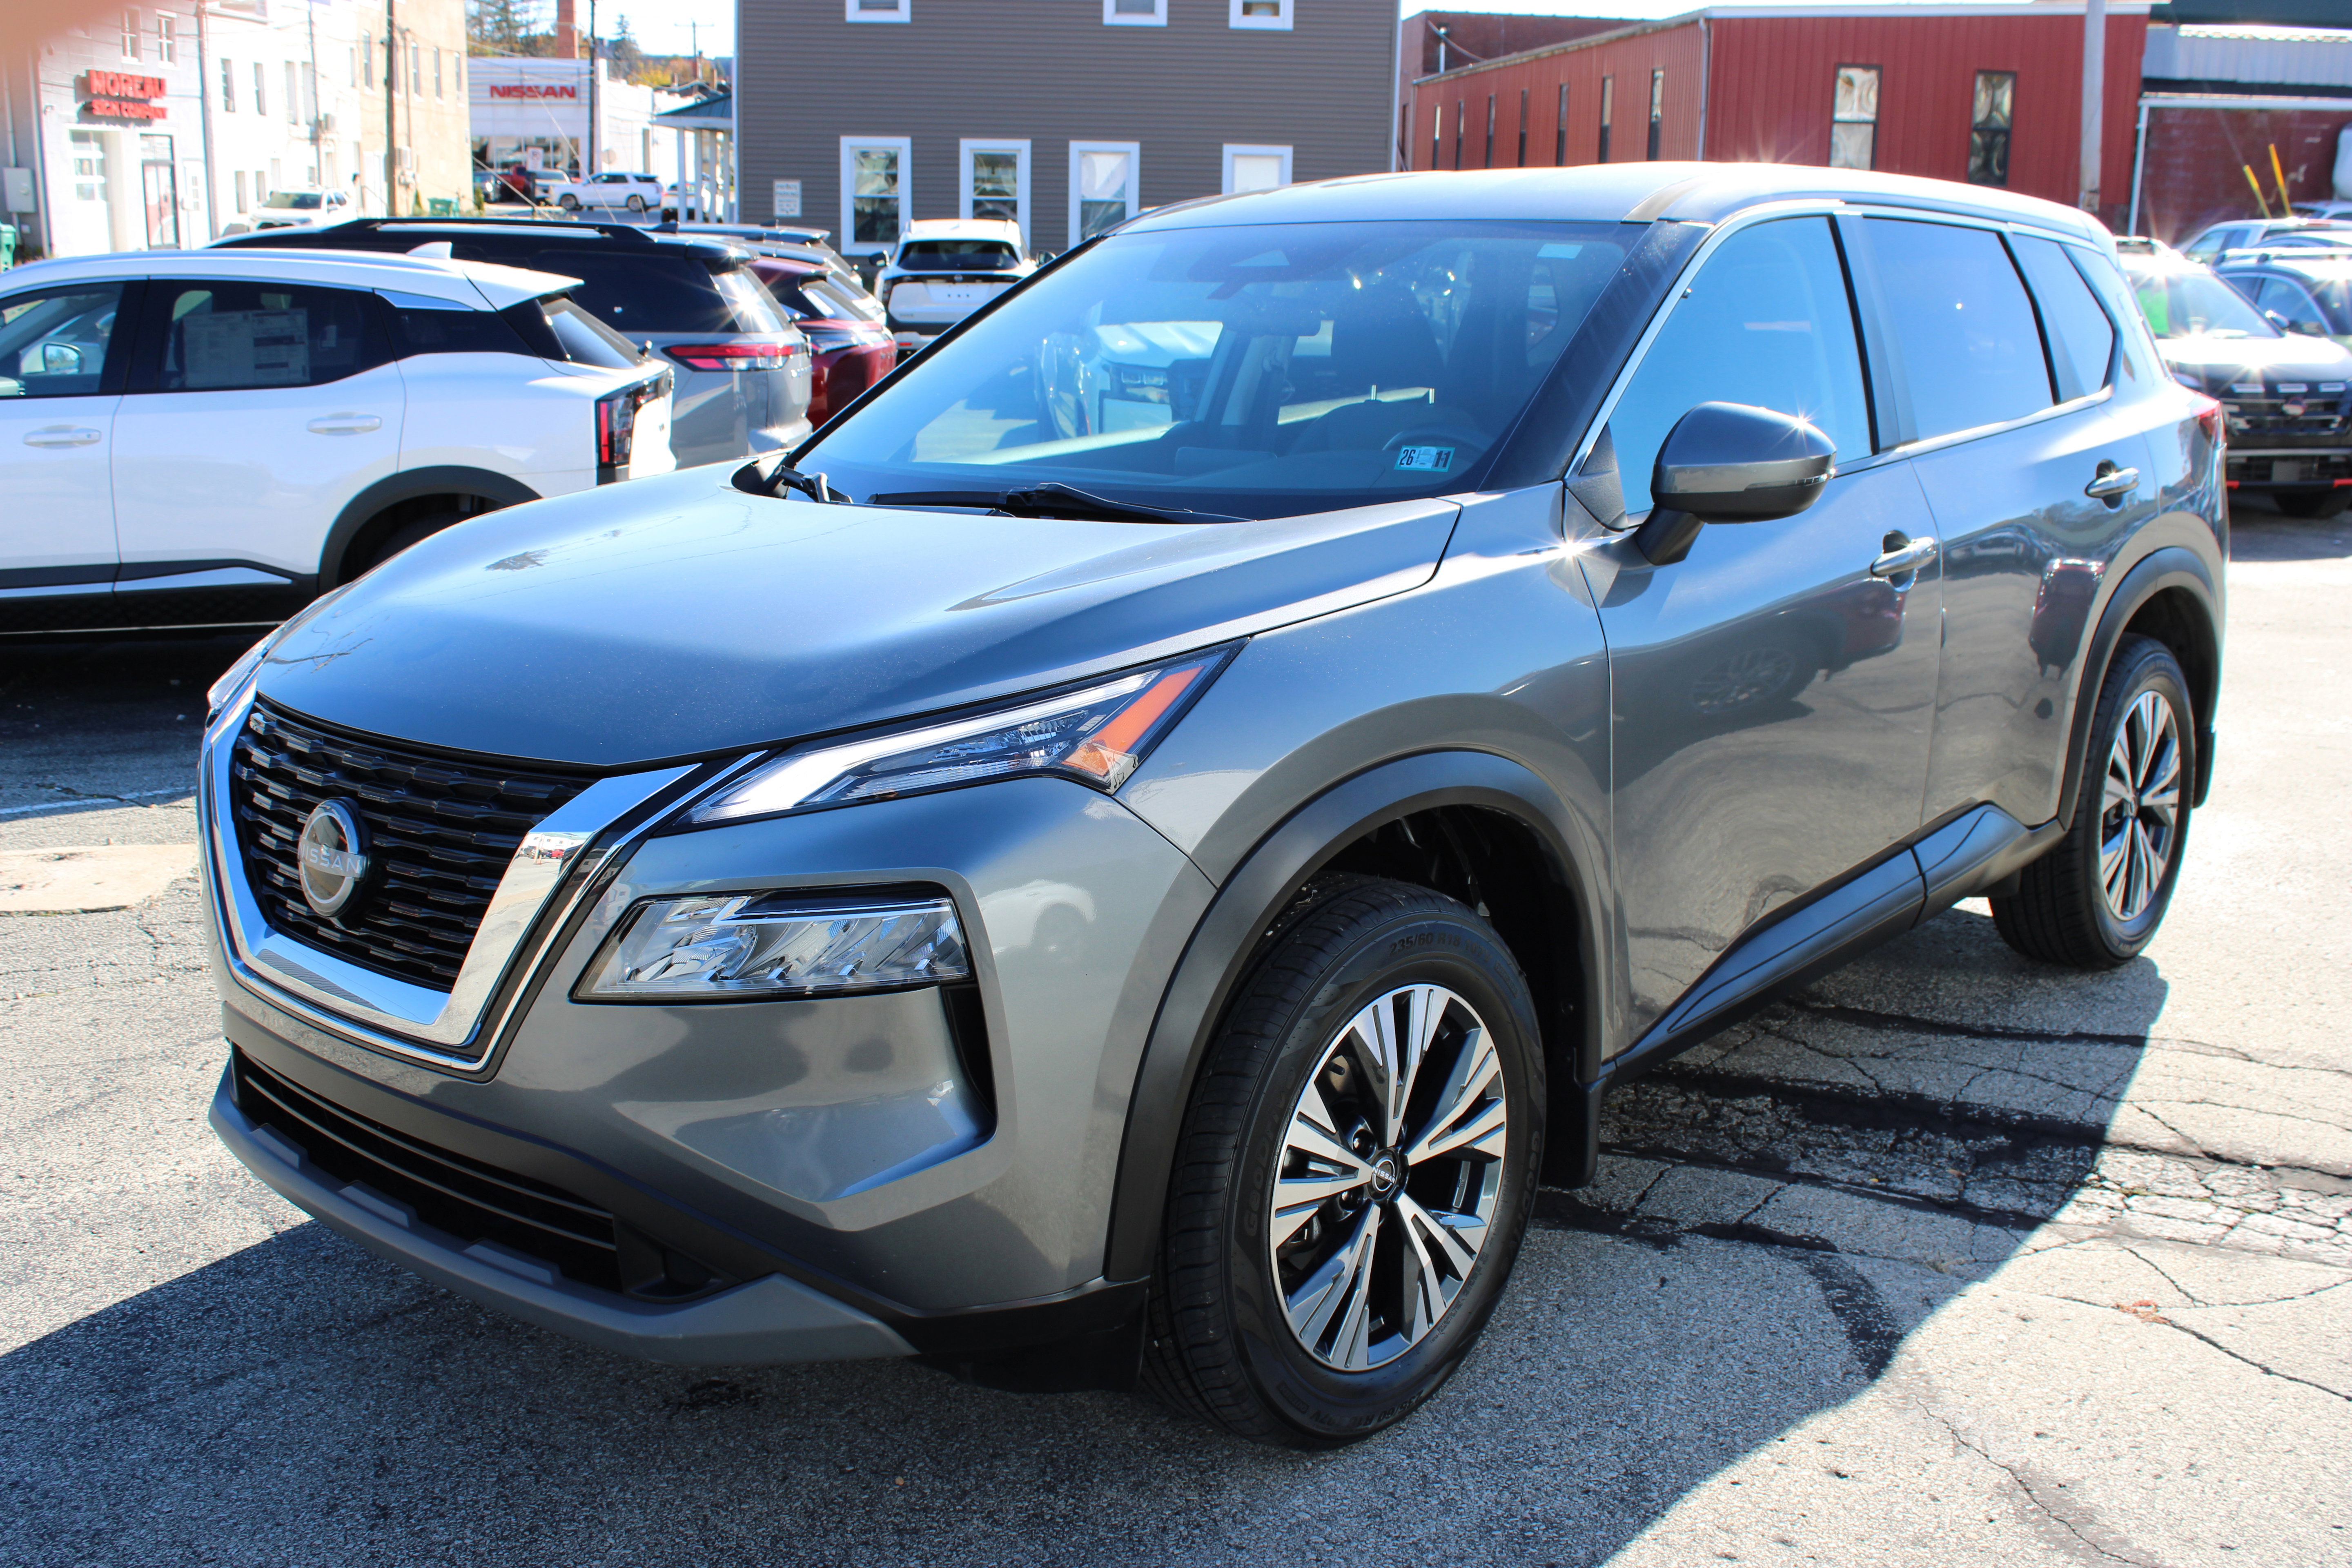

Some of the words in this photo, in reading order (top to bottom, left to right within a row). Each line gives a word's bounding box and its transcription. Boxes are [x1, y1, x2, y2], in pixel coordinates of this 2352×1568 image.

[90, 69, 166, 98] MOREAU
[490, 85, 576, 98] NISSAN
[92, 99, 120, 117] SIGN
[1399, 449, 1416, 466] 26
[1434, 450, 1451, 468] 11
[298, 842, 361, 873] NISSAN
[1389, 932, 1434, 956] 235/60
[1437, 933, 1461, 947] R18
[1372, 1166, 1395, 1184] NISSAN
